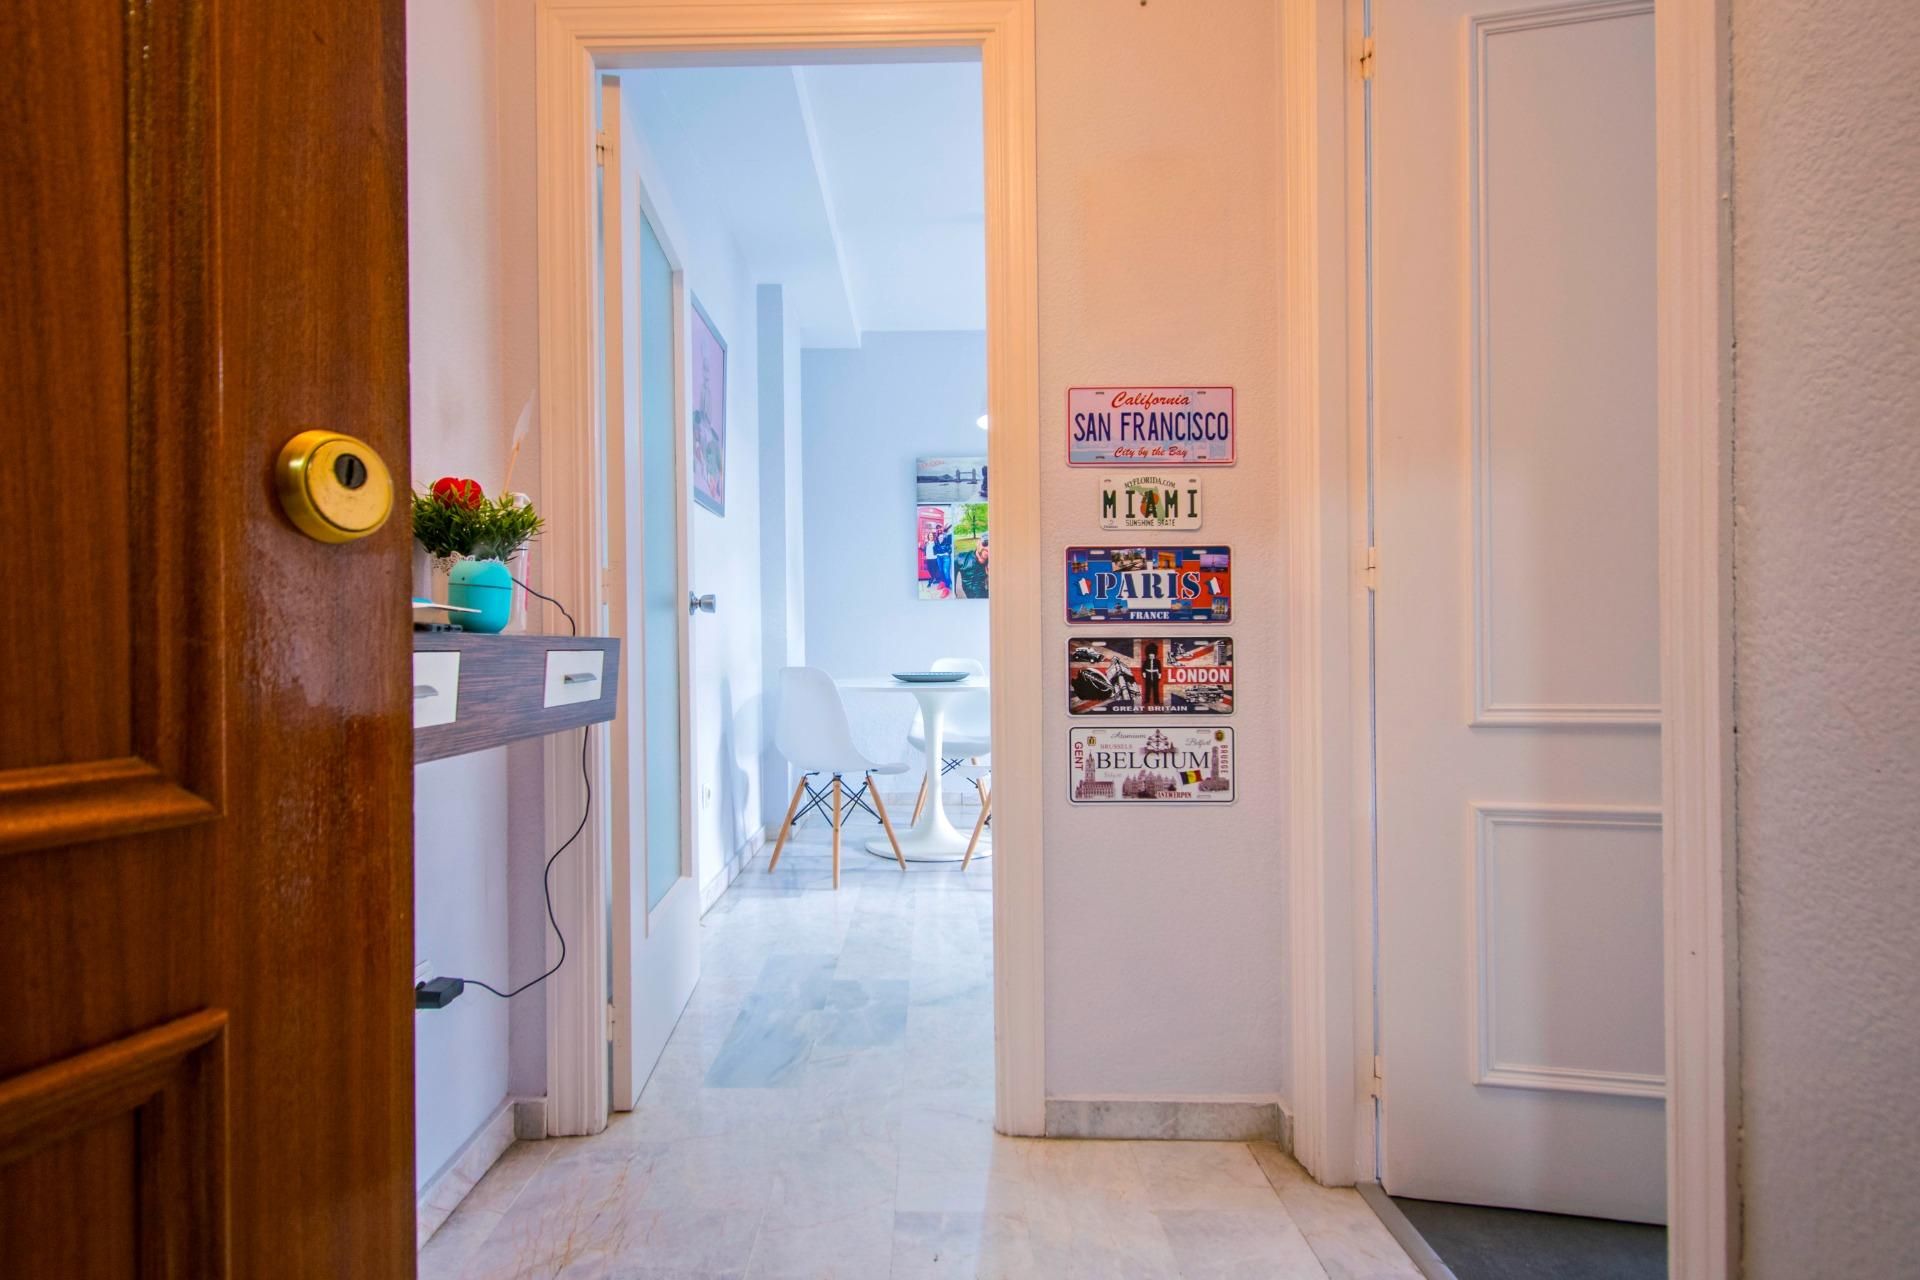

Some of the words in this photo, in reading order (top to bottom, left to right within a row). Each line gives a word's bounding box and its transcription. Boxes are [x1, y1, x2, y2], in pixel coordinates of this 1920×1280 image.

[1112, 391, 1191, 410] California
[1074, 412, 1111, 441] SAN
[1121, 412, 1229, 441] FRANCISCO
[1114, 446, 1135, 458] City
[1138, 446, 1149, 458] by
[1152, 446, 1165, 456] the
[1169, 446, 1188, 458] Bay
[1103, 489, 1198, 518] MIAMI
[1125, 519, 1155, 527] SUNSHINE
[1157, 518, 1176, 527] STATE
[1095, 572, 1201, 600] PARIS
[1129, 611, 1170, 620] FRANCE
[1167, 668, 1230, 683] LONDON
[1074, 741, 1084, 771] GENT
[1096, 751, 1210, 769] BELGIUM
[1220, 744, 1229, 774] BRUGGE
